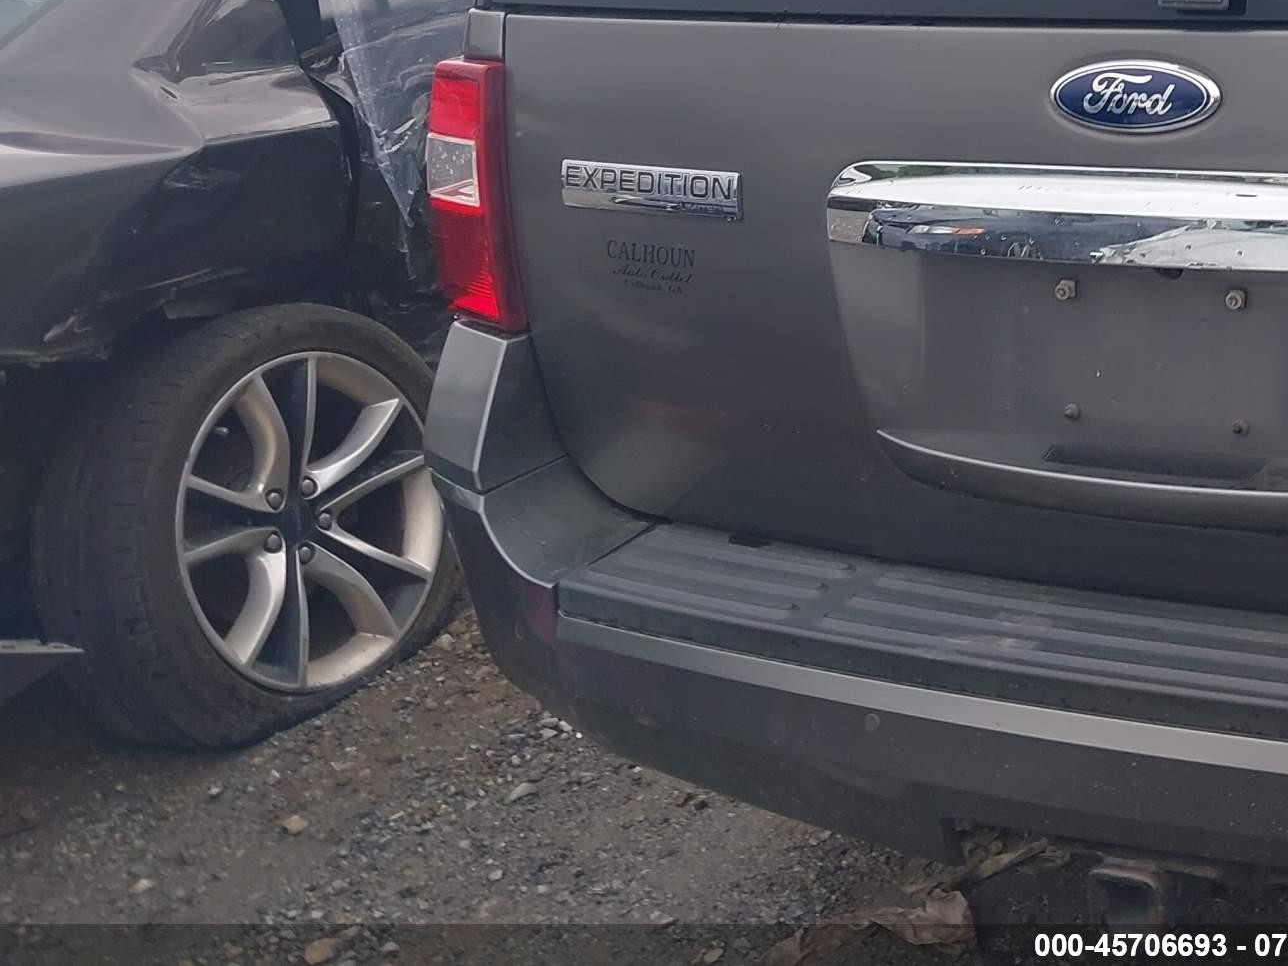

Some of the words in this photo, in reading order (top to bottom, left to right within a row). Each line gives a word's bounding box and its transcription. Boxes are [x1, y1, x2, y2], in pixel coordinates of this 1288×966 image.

[1083, 72, 1175, 115] Ford
[565, 165, 733, 200] EXPEDITION
[607, 239, 696, 269] CALHOUN
